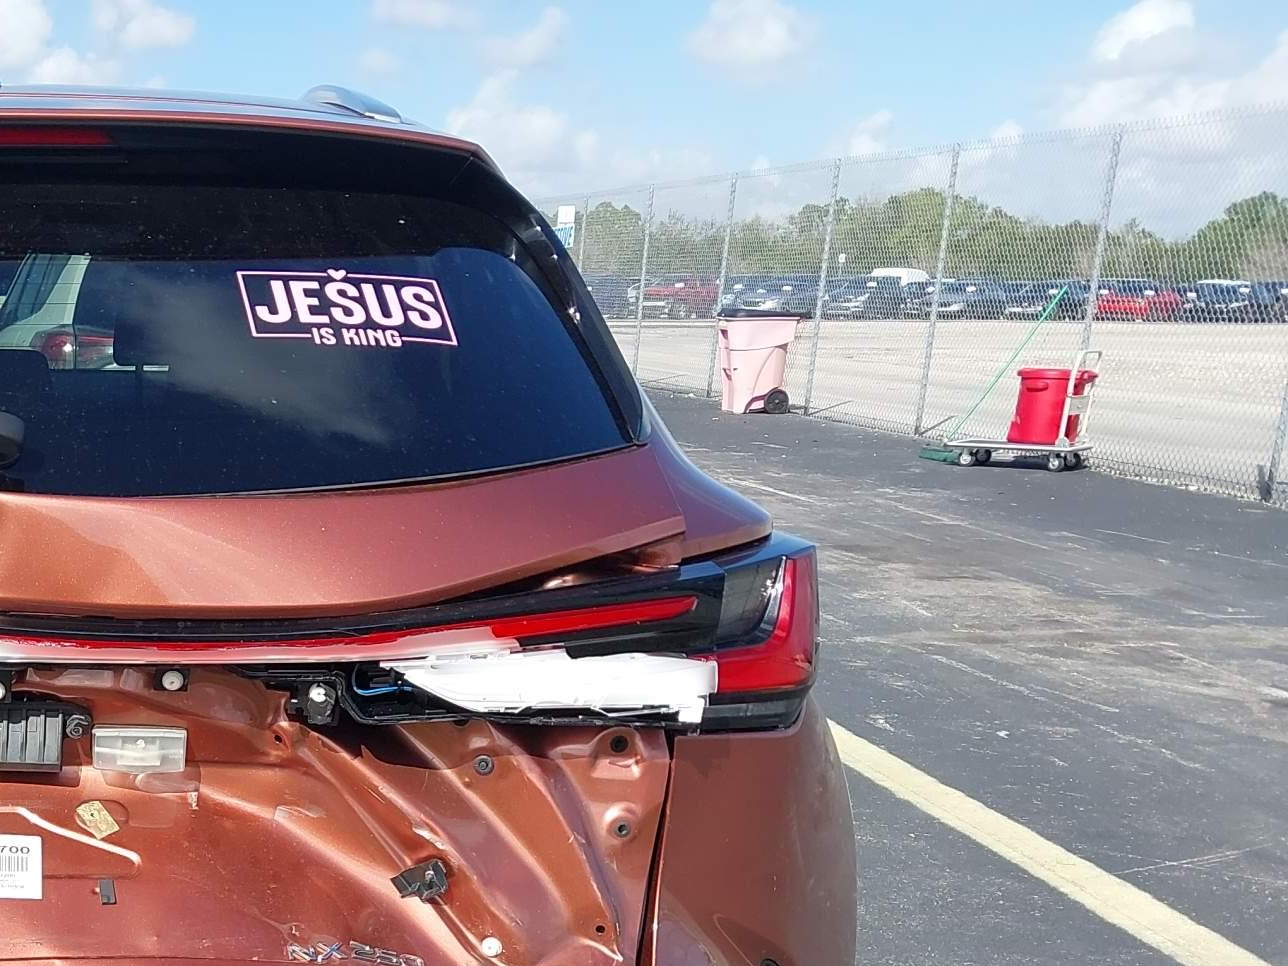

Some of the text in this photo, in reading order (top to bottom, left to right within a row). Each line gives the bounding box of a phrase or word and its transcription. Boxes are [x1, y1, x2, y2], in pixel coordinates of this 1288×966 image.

[255, 280, 443, 329] JESUS
[311, 327, 403, 347] IS KING
[286, 942, 348, 963] NX
